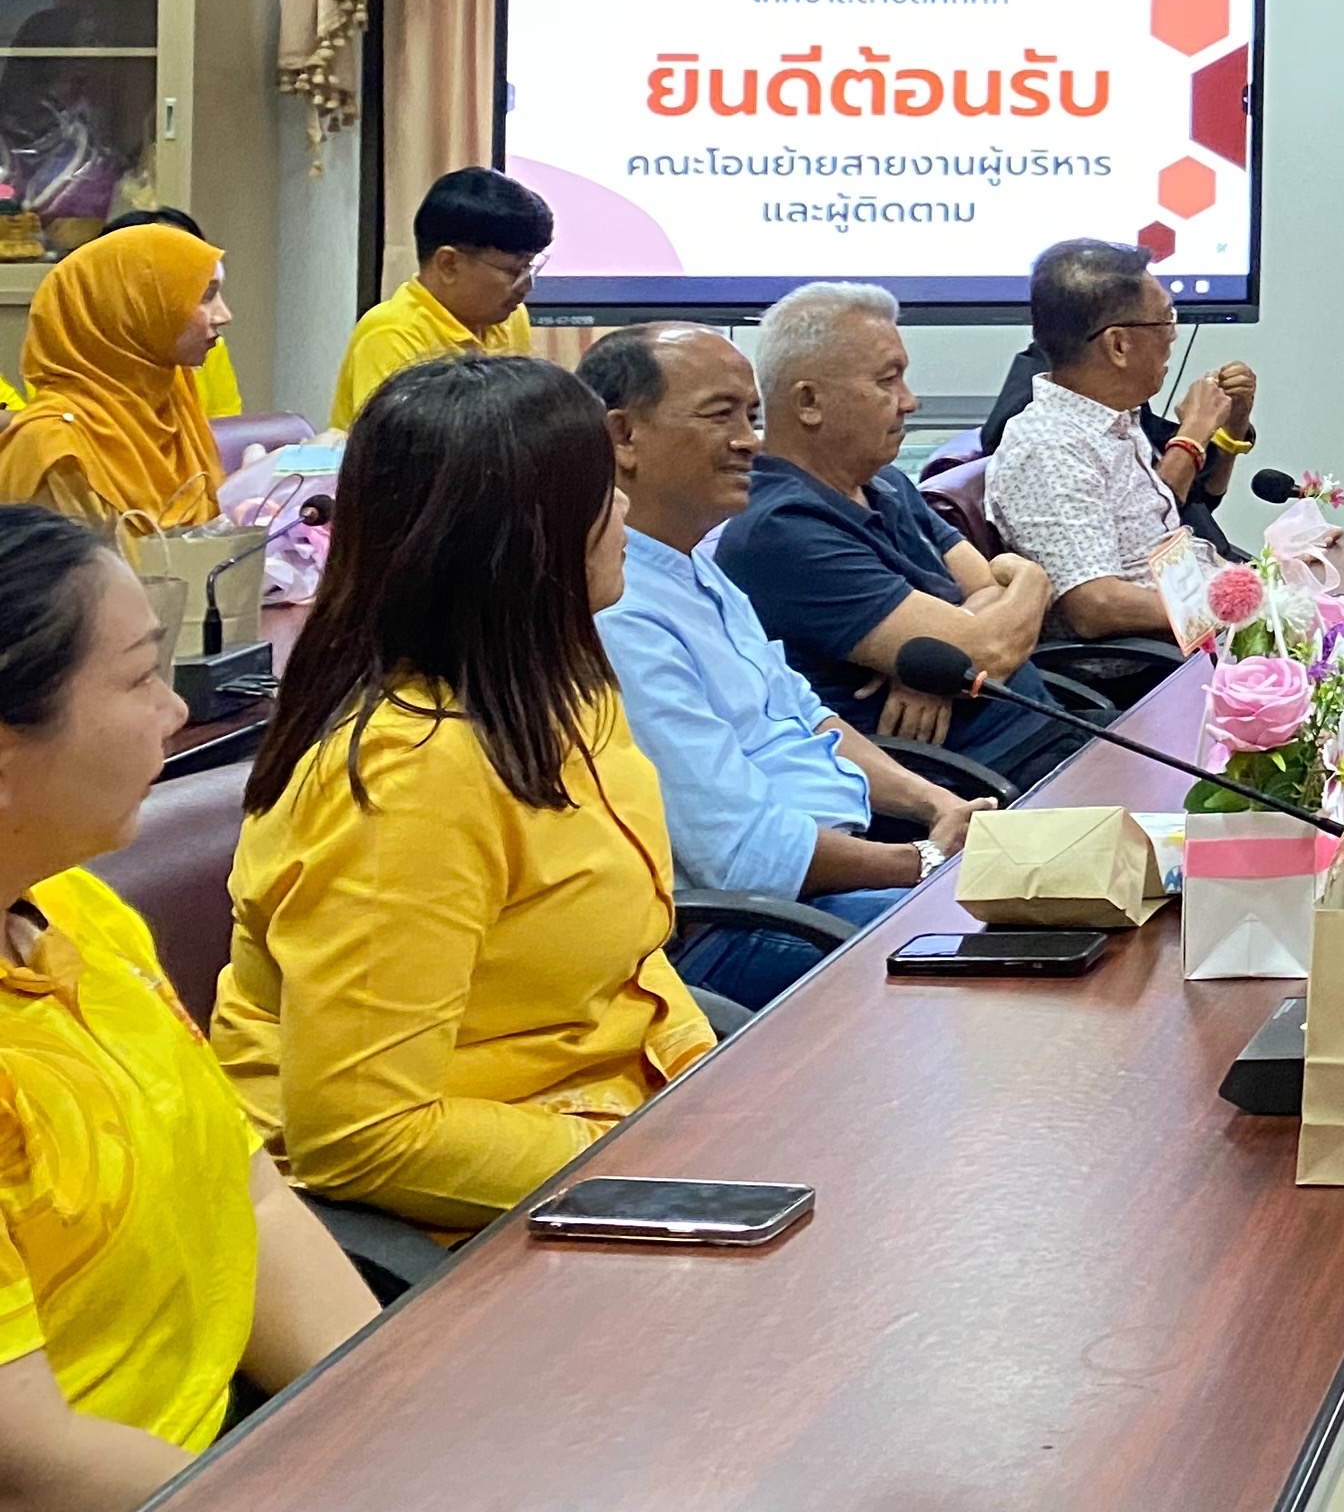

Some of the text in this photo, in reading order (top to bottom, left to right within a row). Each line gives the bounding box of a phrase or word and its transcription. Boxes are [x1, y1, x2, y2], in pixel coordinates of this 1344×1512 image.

[646, 44, 1110, 117] ยินดีต้อนรับ
[627, 146, 1113, 187] คณะโอนย้ายสายงานผู้บริหาร
[762, 192, 976, 233] และผู้ติดตาม
